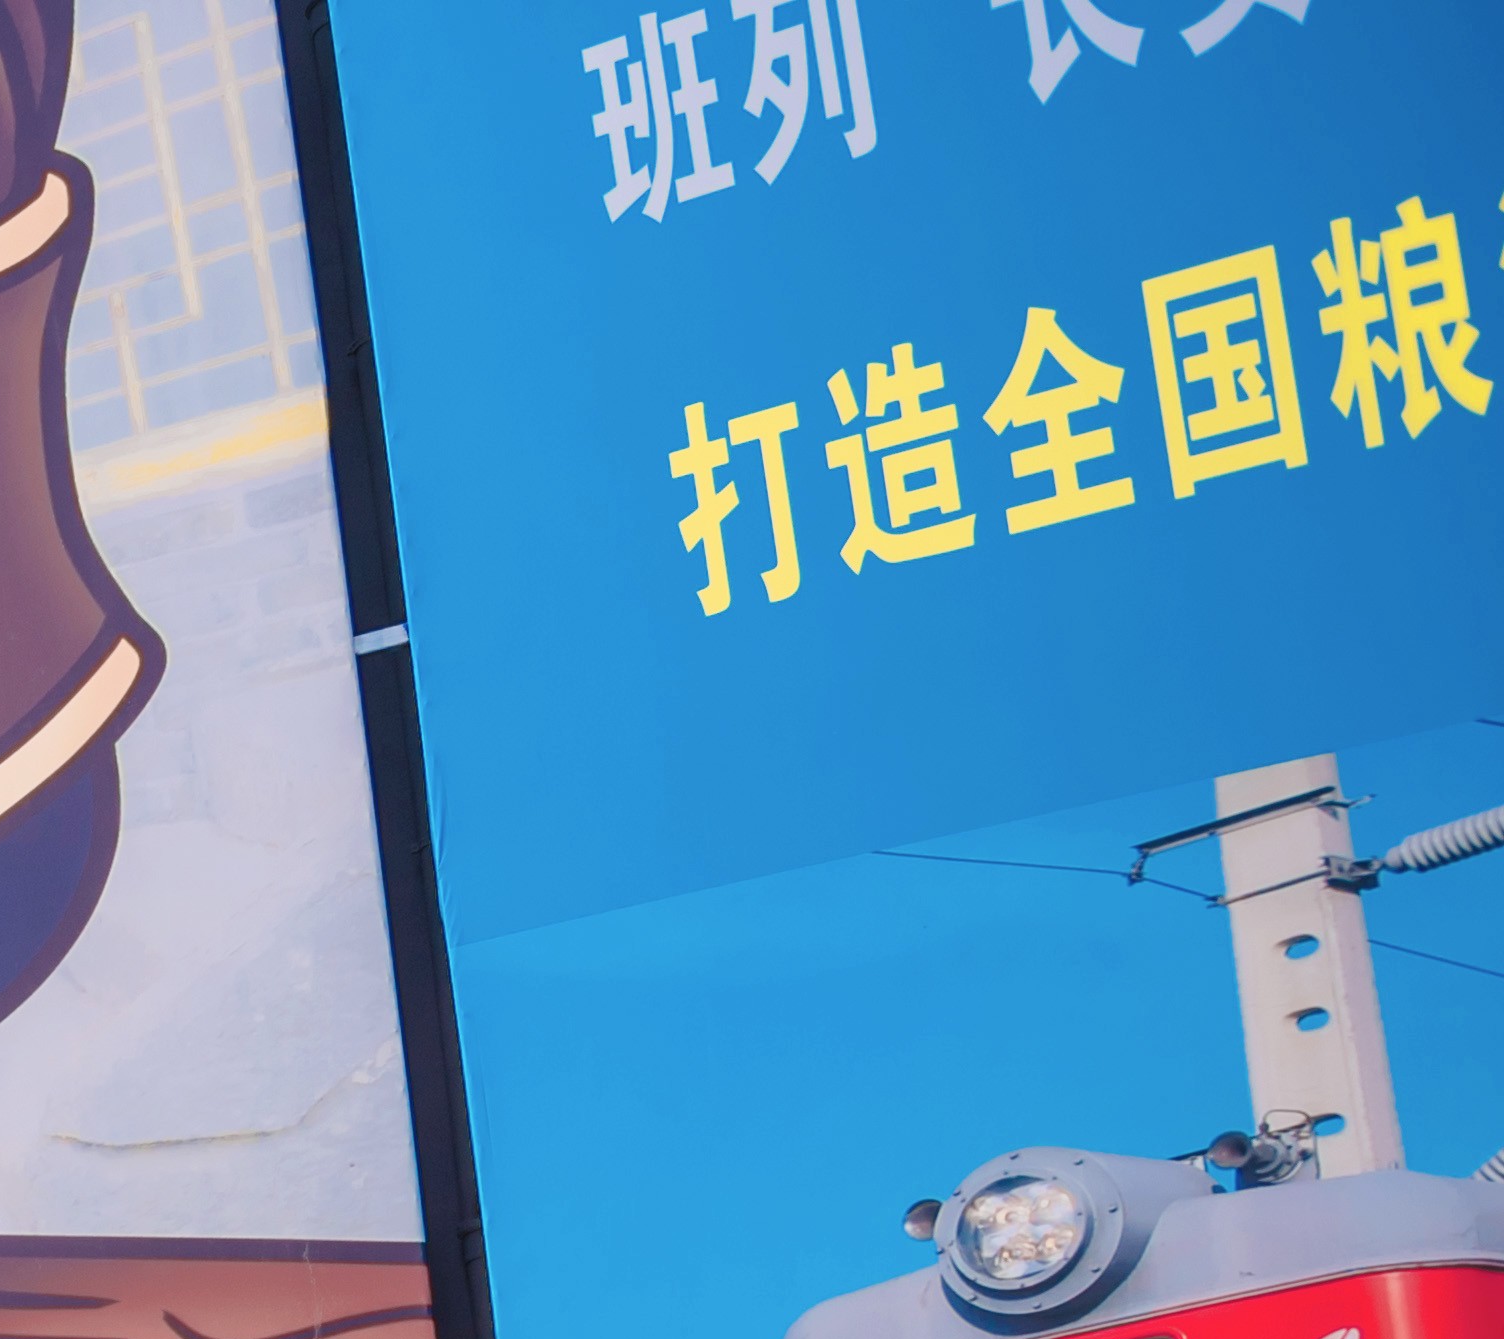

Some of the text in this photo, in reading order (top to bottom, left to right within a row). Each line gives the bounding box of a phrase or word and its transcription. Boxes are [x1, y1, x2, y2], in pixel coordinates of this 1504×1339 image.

[582, 0, 877, 223] 班列
[669, 195, 1504, 617] 打造全国粮
